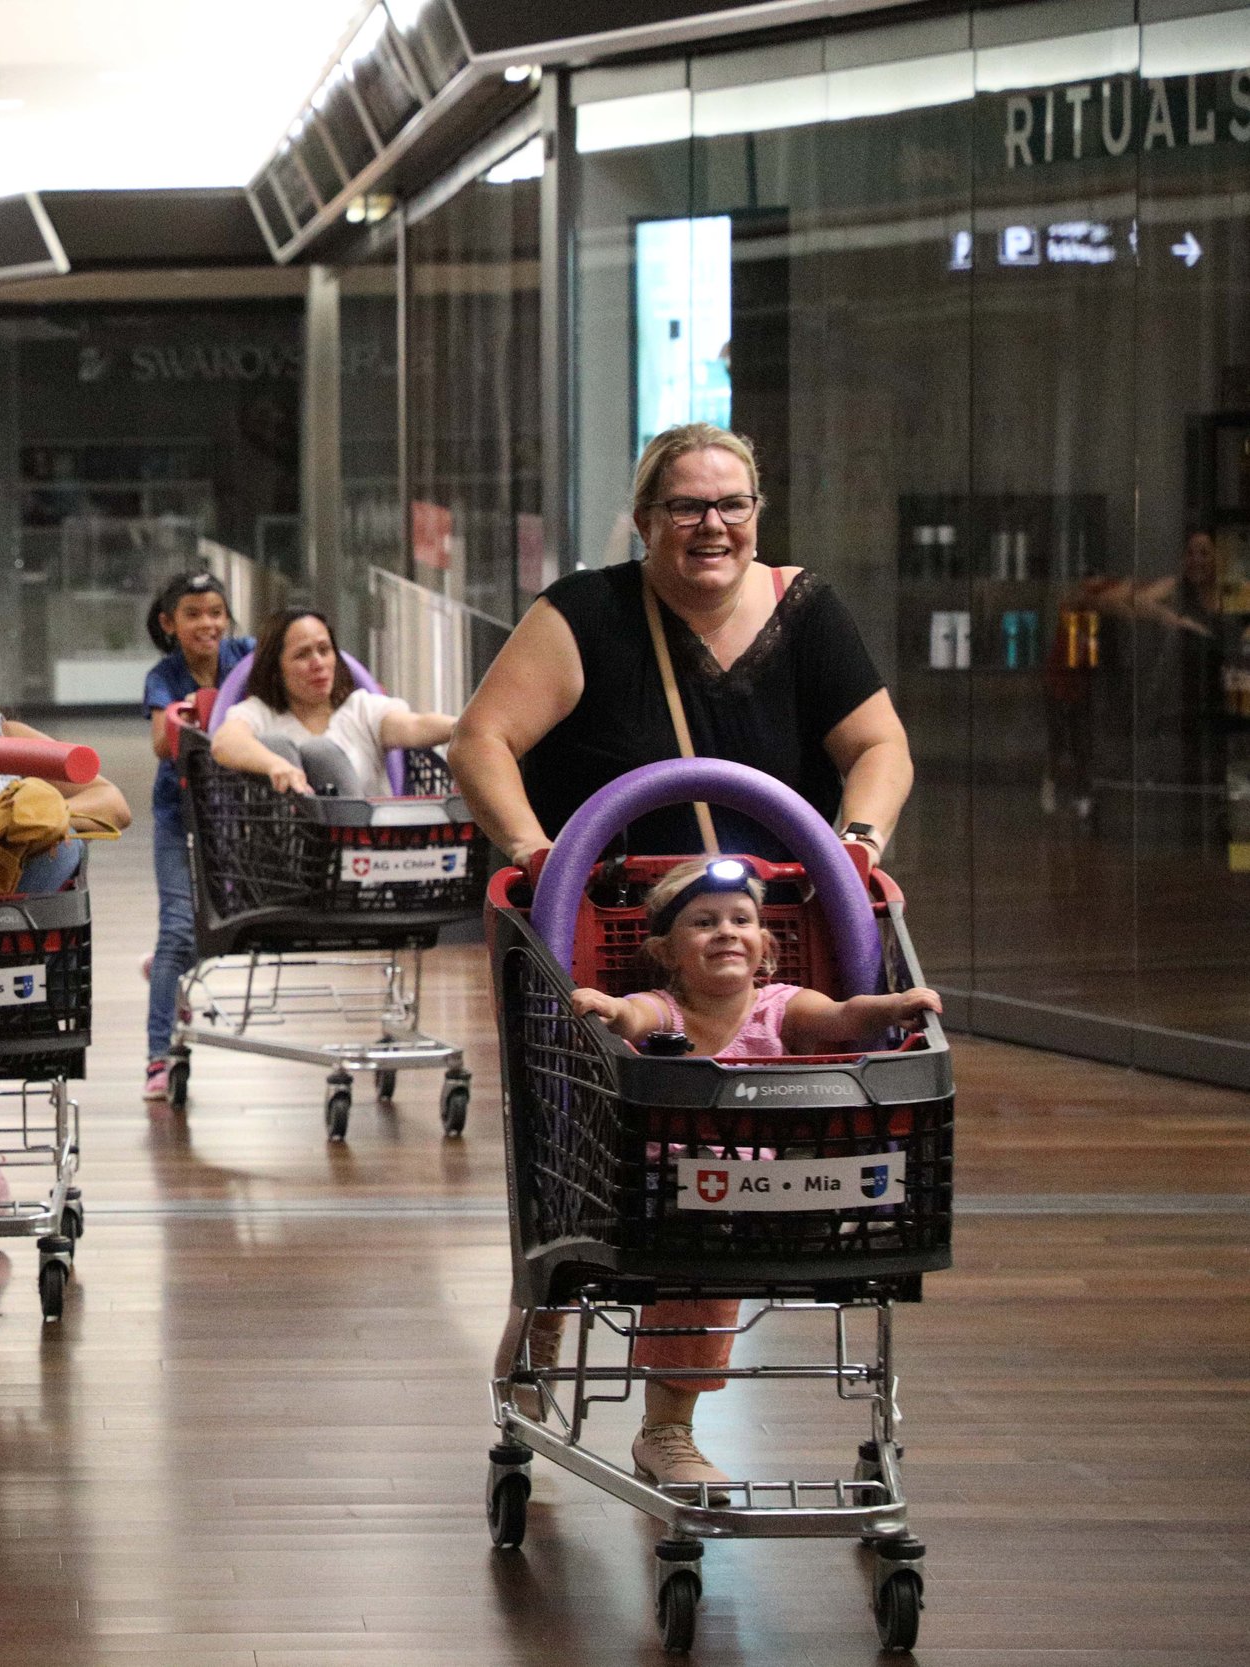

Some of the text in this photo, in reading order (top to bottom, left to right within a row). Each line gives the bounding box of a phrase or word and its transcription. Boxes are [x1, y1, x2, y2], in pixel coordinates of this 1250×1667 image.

[1004, 68, 1250, 169] RITUALS
[760, 1083, 854, 1097] SHOPPI TIVOLI
[739, 1175, 841, 1194] AG Mia
